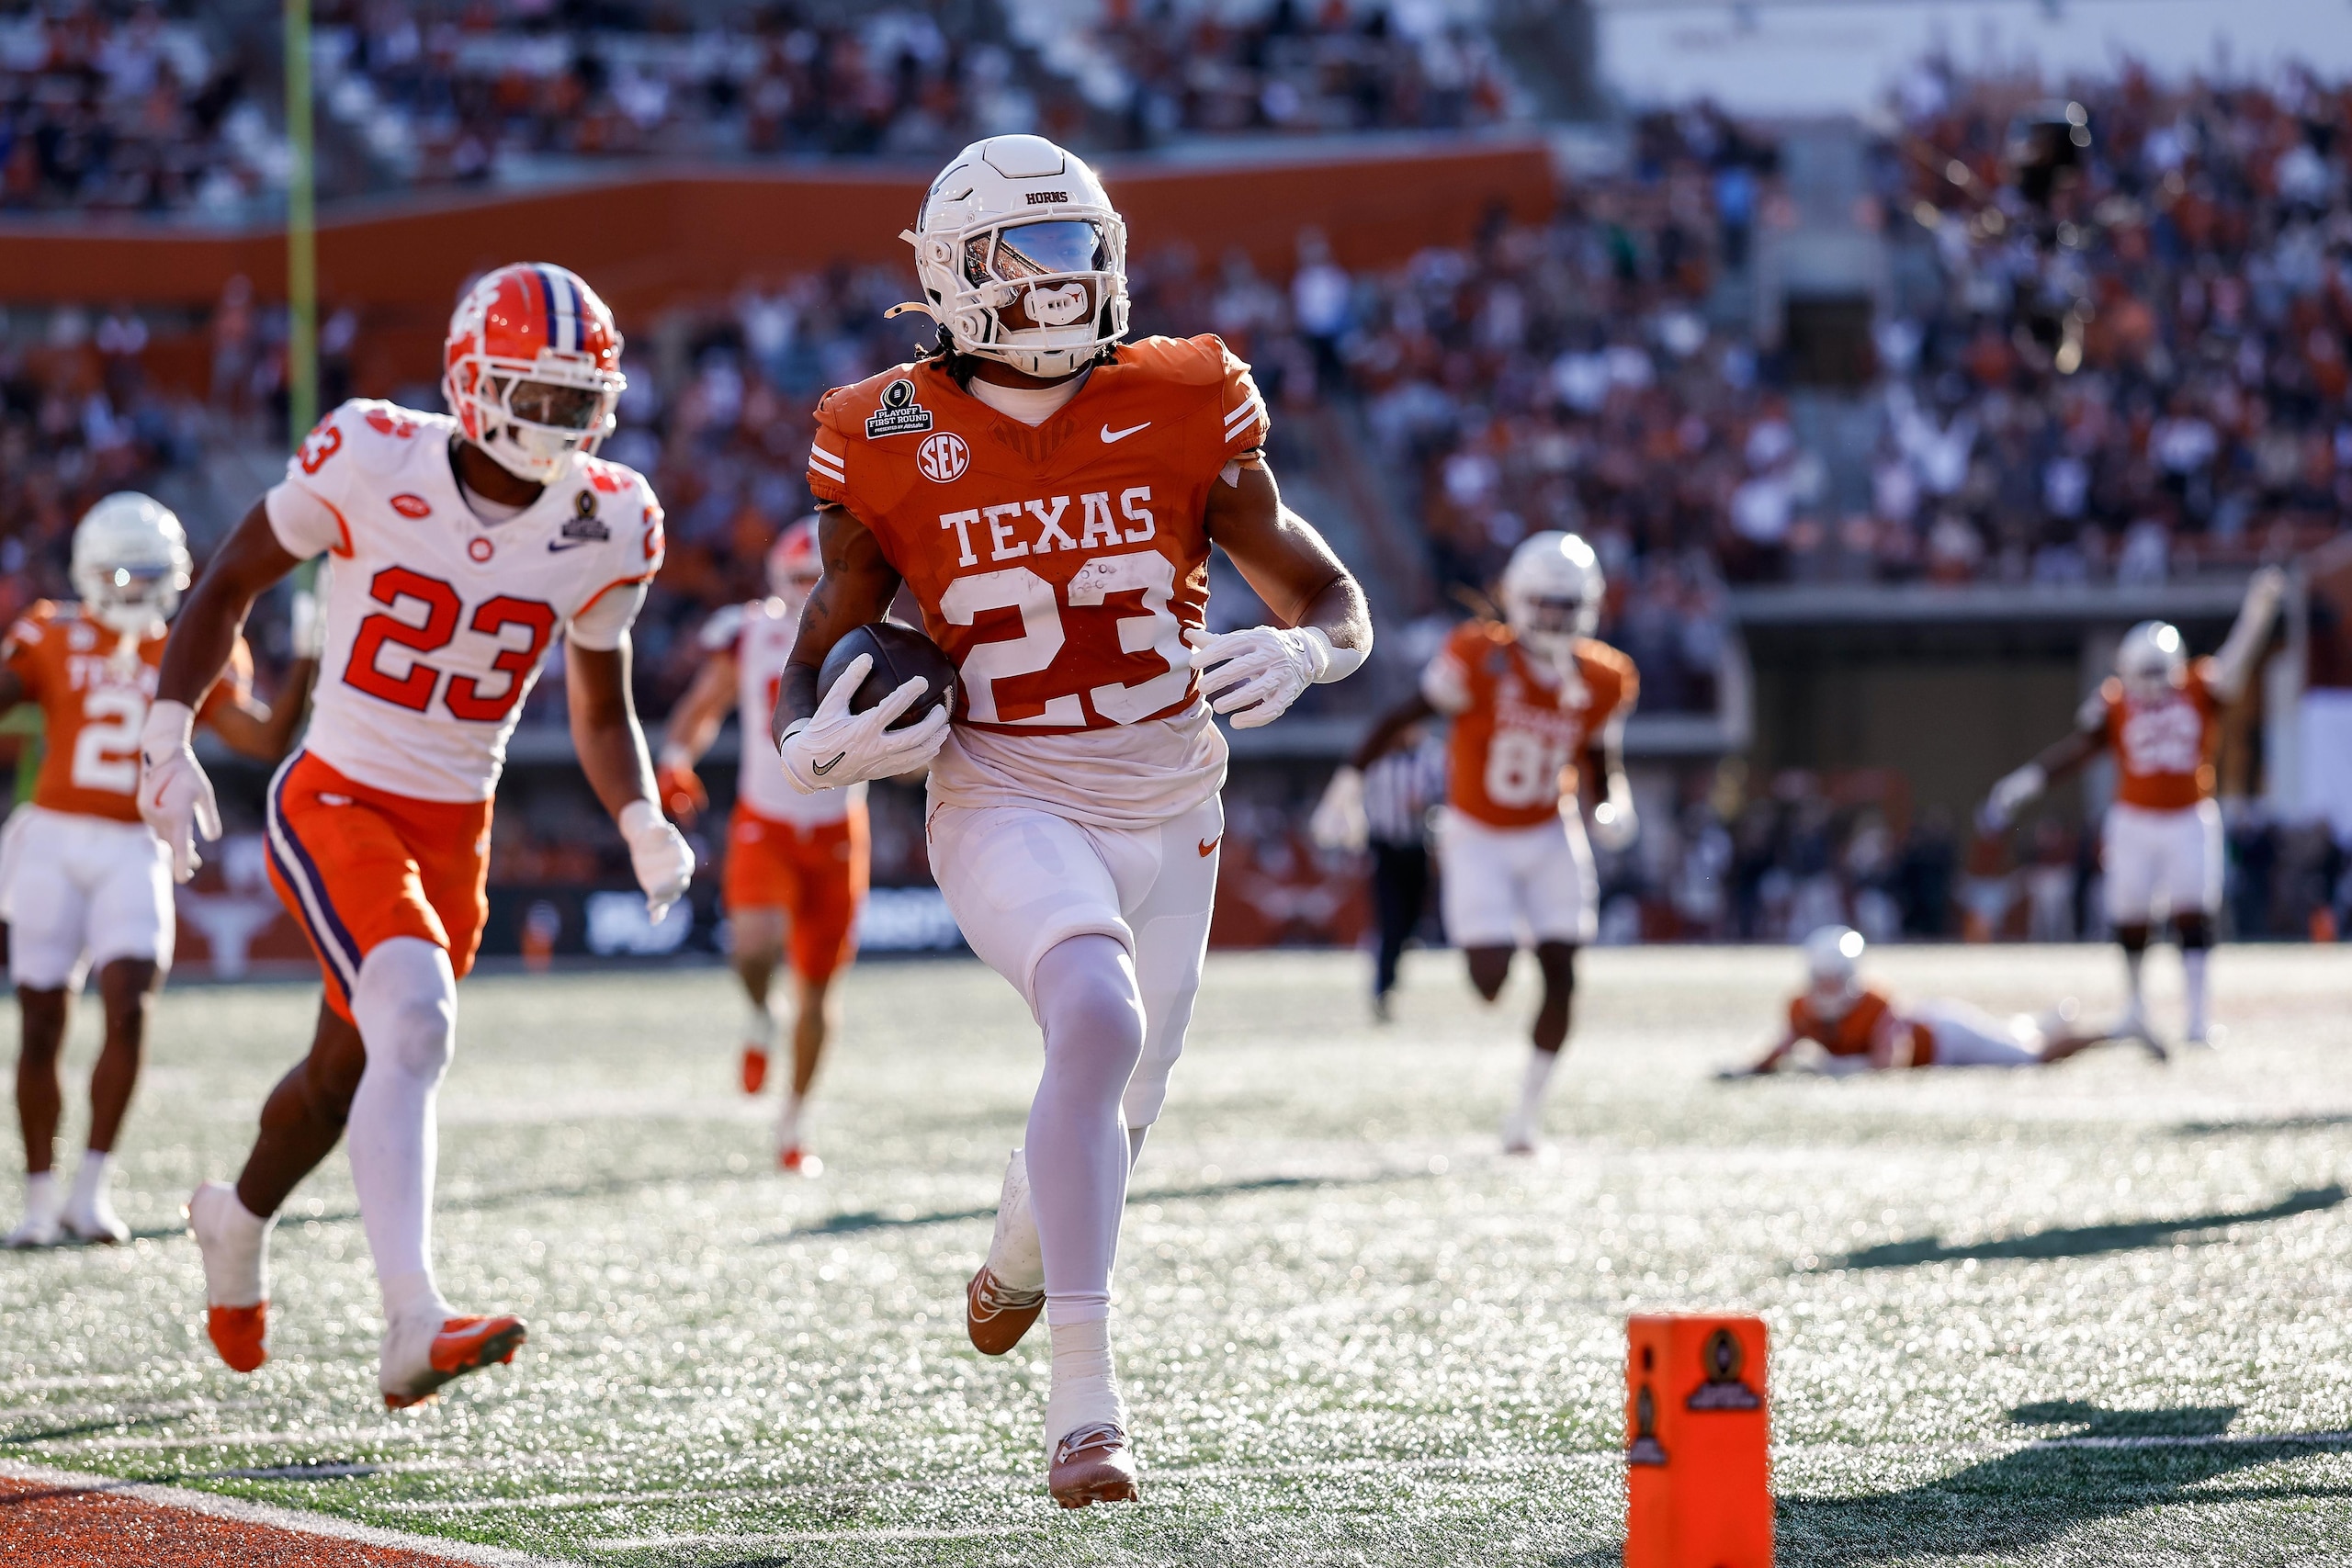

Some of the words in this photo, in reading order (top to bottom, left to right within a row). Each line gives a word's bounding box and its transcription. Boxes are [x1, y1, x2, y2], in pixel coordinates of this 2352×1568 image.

[1025, 191, 1069, 205] HORNS
[869, 417, 896, 427] FIRST
[897, 413, 928, 423] ROUND
[878, 407, 918, 418] PLAYOFF
[921, 435, 966, 479] SEC
[939, 486, 1157, 568] TEXAS
[343, 566, 557, 721] 23
[939, 549, 1192, 727] 23
